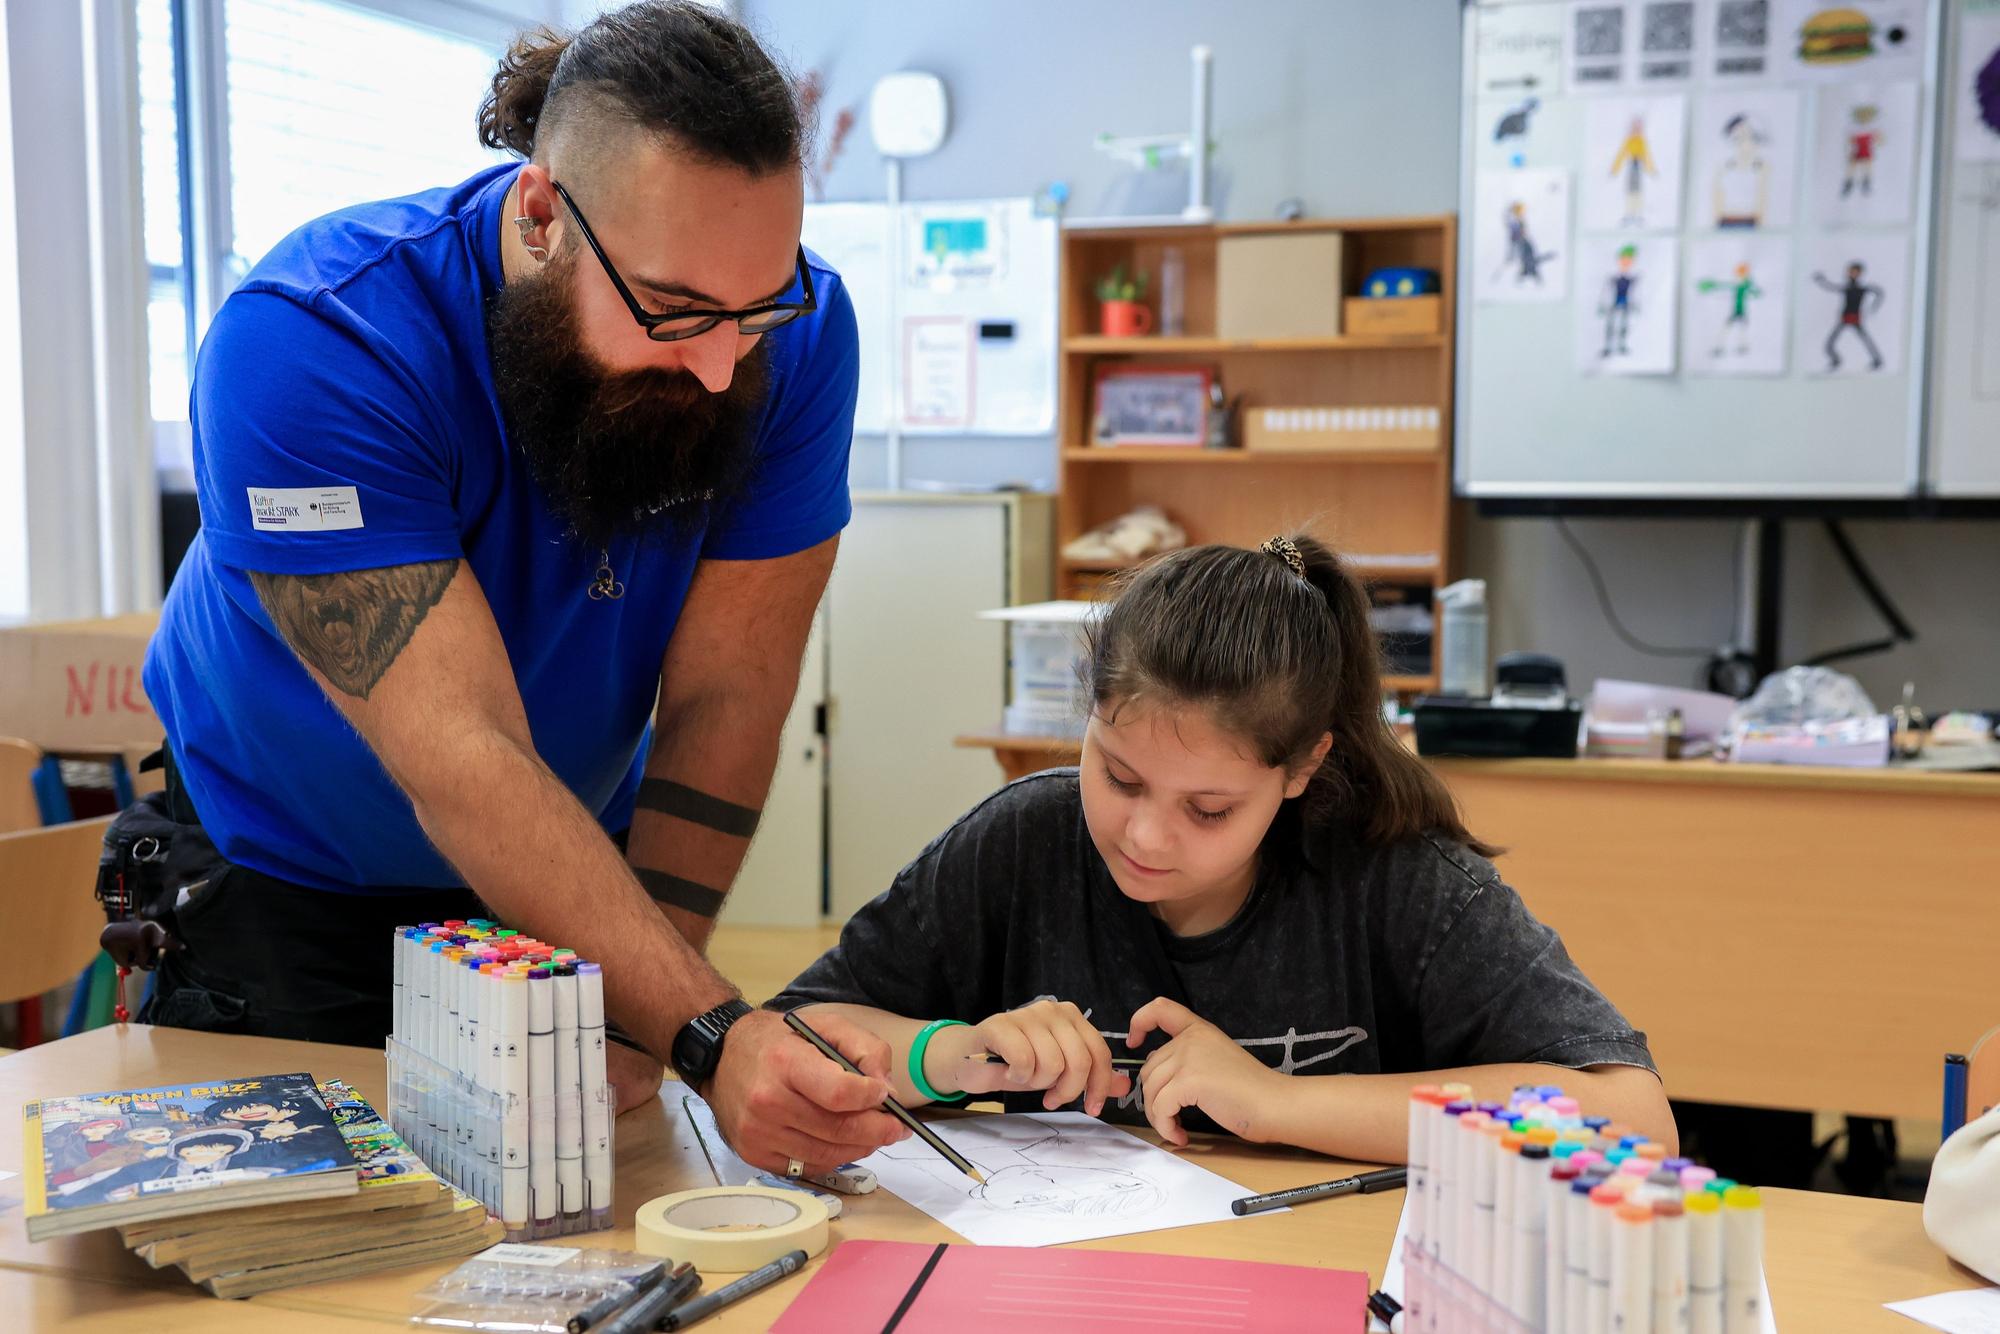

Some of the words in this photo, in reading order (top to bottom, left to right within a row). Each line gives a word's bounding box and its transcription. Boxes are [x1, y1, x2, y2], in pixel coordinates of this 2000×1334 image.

[253, 494, 275, 506] Kultur
[276, 506, 300, 517] STARK
[190, 1081, 262, 1098] BUZZ
